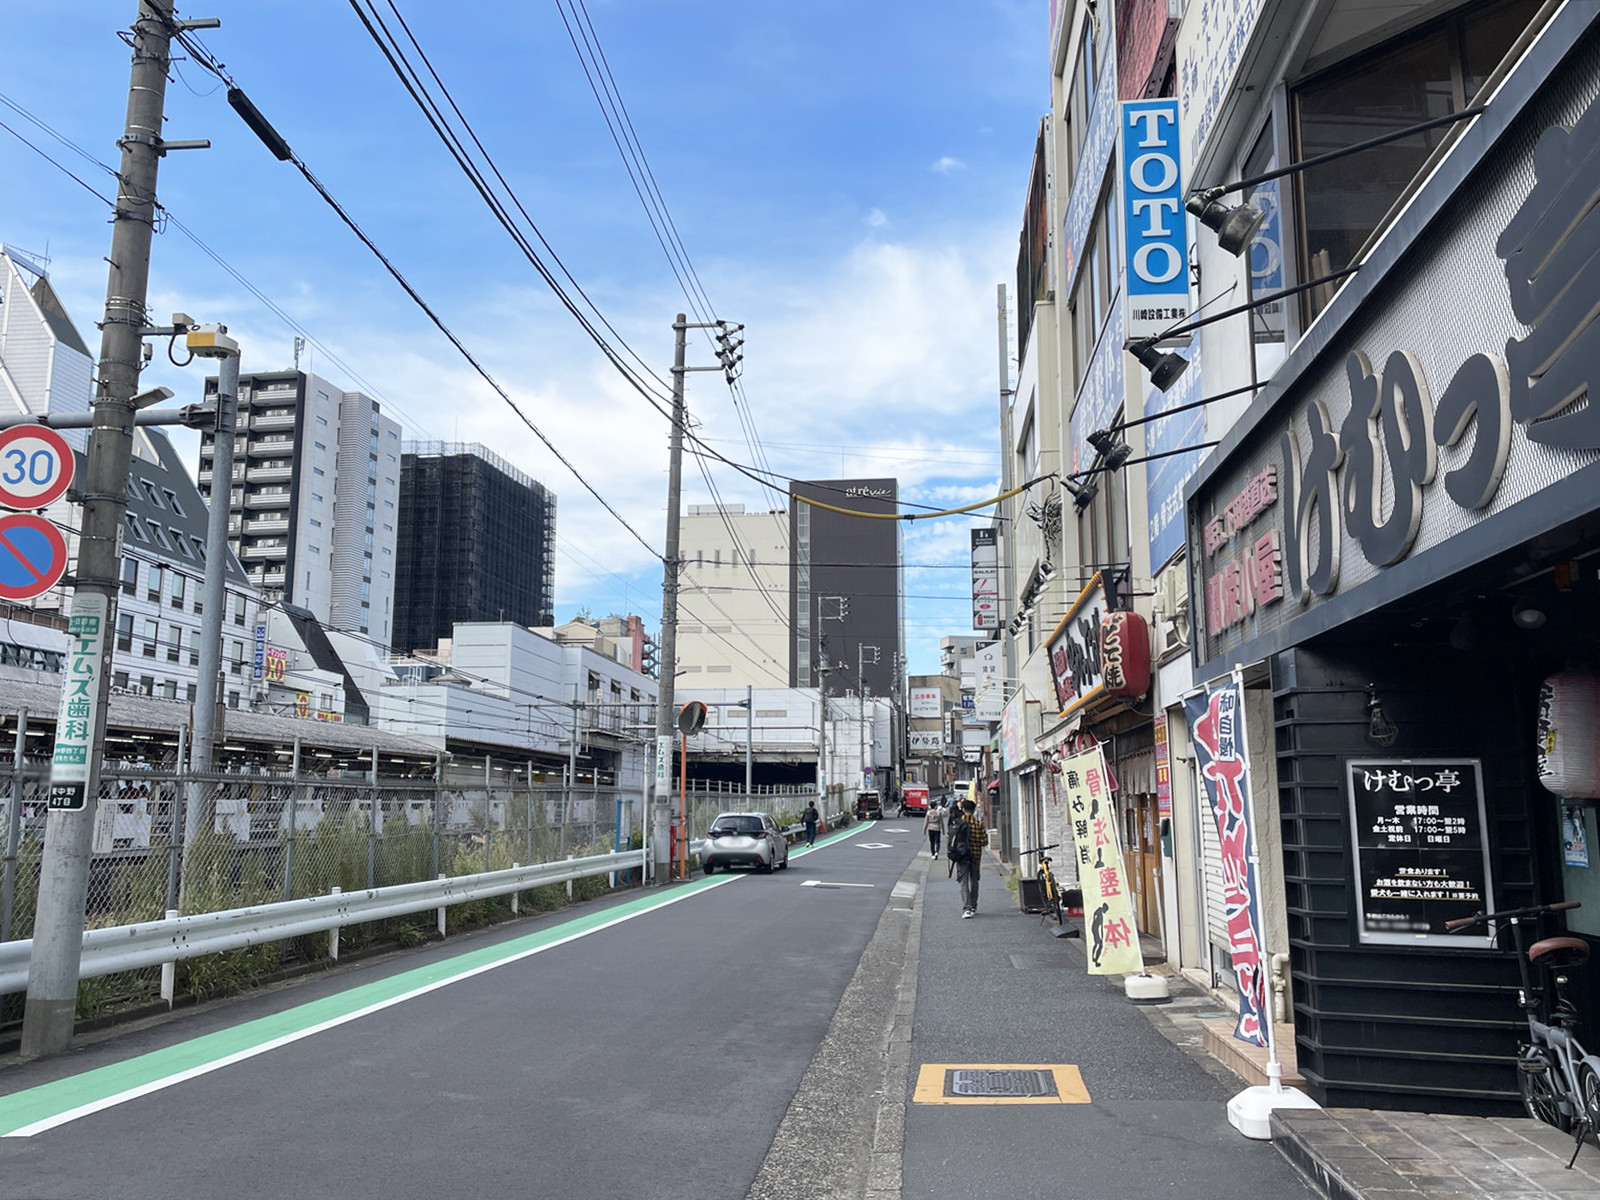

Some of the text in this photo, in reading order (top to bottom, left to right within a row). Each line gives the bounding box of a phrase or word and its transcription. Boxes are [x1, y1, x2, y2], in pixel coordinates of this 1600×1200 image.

[1130, 108, 1182, 284] TOTO
[3, 449, 54, 486] 30
[65, 638, 98, 740] エムズ歯科
[1363, 769, 1461, 793] けむっ亭
[1394, 804, 1439, 816] 営業時間
[1388, 834, 1451, 844] 定休日 日曜日
